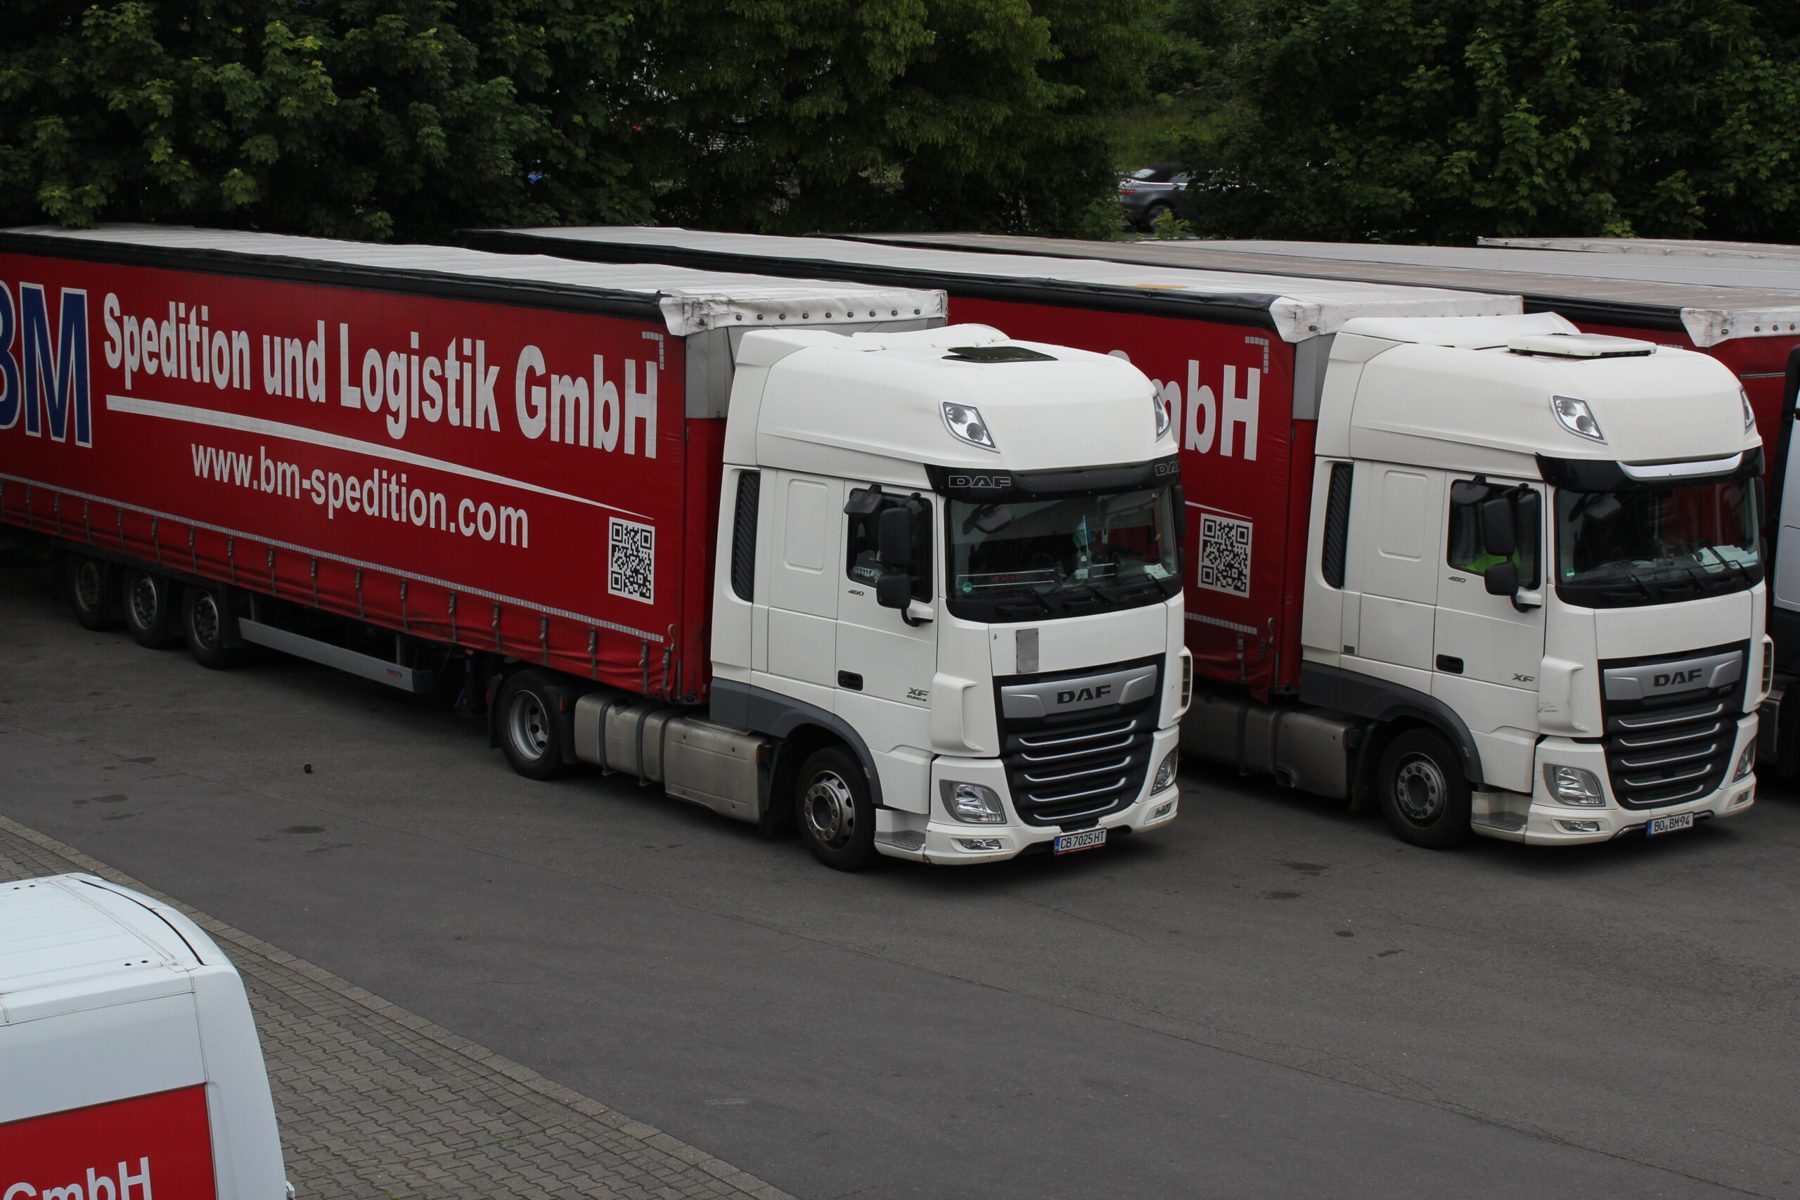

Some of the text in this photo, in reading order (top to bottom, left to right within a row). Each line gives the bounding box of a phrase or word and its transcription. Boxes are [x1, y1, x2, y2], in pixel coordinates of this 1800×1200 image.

[103, 292, 657, 459] Spedition und Logistik GmbH
[1107, 349, 1261, 461] bH
[1155, 461, 1179, 477] DA
[949, 475, 1011, 488] DAF
[191, 443, 529, 549] www.bm-spedition.com
[1653, 668, 1702, 687] DAF
[908, 687, 929, 696] XF
[1057, 684, 1111, 704] DAF
